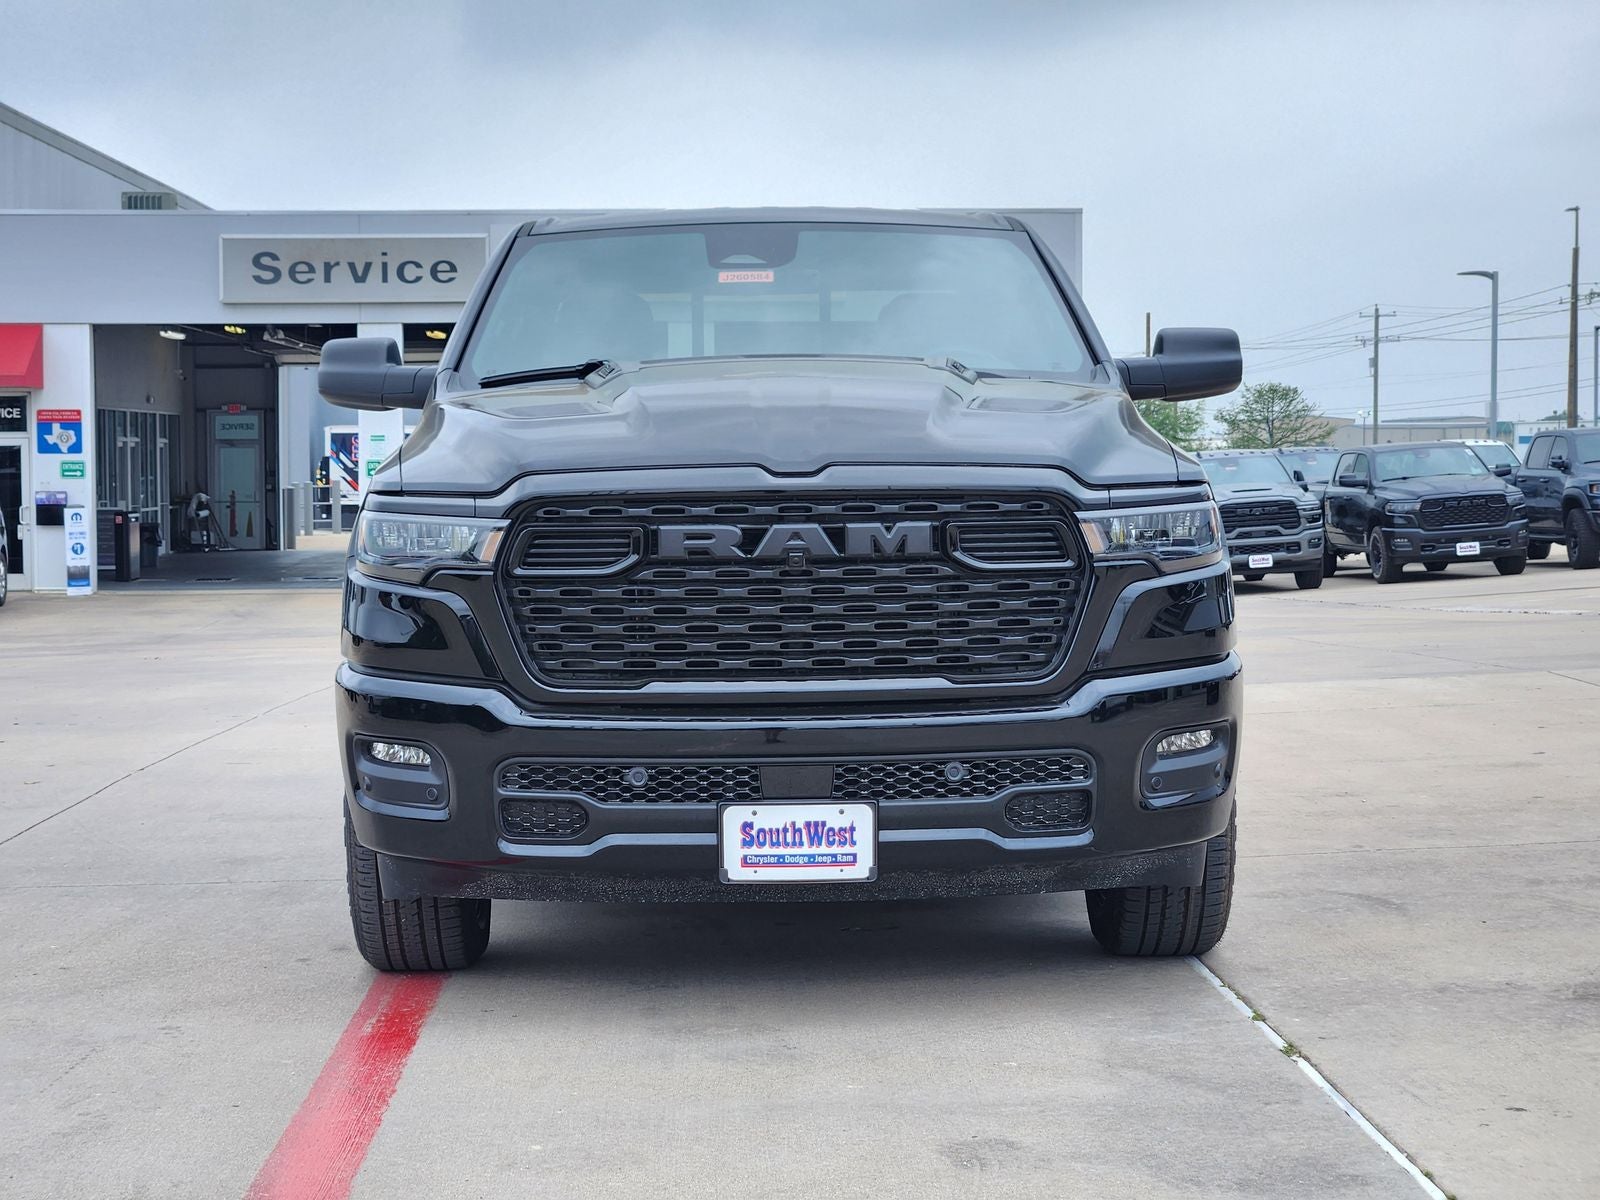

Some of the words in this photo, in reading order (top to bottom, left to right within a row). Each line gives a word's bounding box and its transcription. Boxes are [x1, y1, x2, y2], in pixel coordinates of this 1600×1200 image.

[251, 251, 458, 285] Service
[0, 407, 21, 418] ICE
[657, 521, 934, 559] RAM
[740, 819, 857, 849] SouthWest
[746, 855, 778, 864] Chrysler
[784, 855, 809, 864] Dodge
[814, 854, 832, 864] Jeep
[836, 854, 854, 862] Ram
